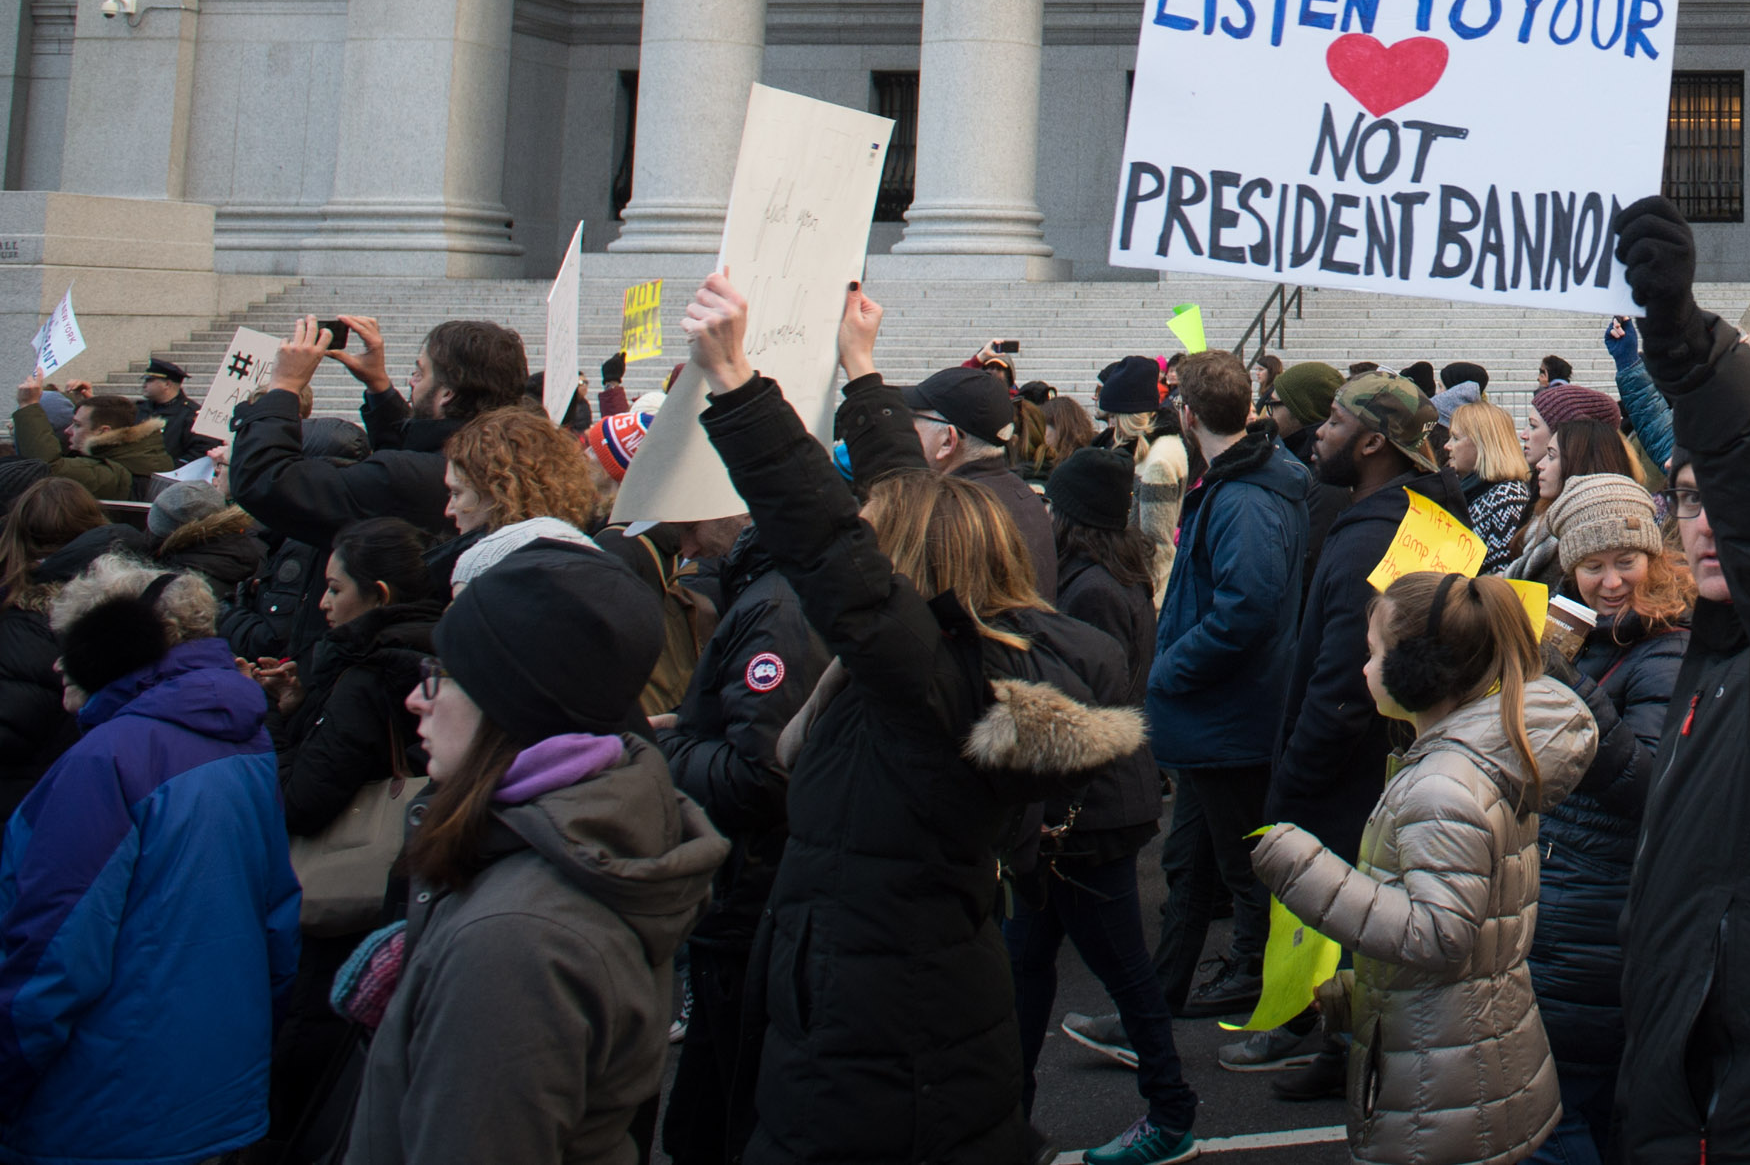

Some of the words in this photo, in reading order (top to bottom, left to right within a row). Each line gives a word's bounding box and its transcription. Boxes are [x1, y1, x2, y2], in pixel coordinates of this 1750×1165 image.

[1309, 102, 1470, 184] NOT
[1119, 161, 1431, 280] PRESIDENT
[625, 281, 660, 310] NOT
[63, 321, 77, 346] YORK
[204, 406, 230, 425] MEA
[1410, 499, 1422, 516] I
[1429, 504, 1453, 534] lift
[1397, 522, 1430, 563] lamp
